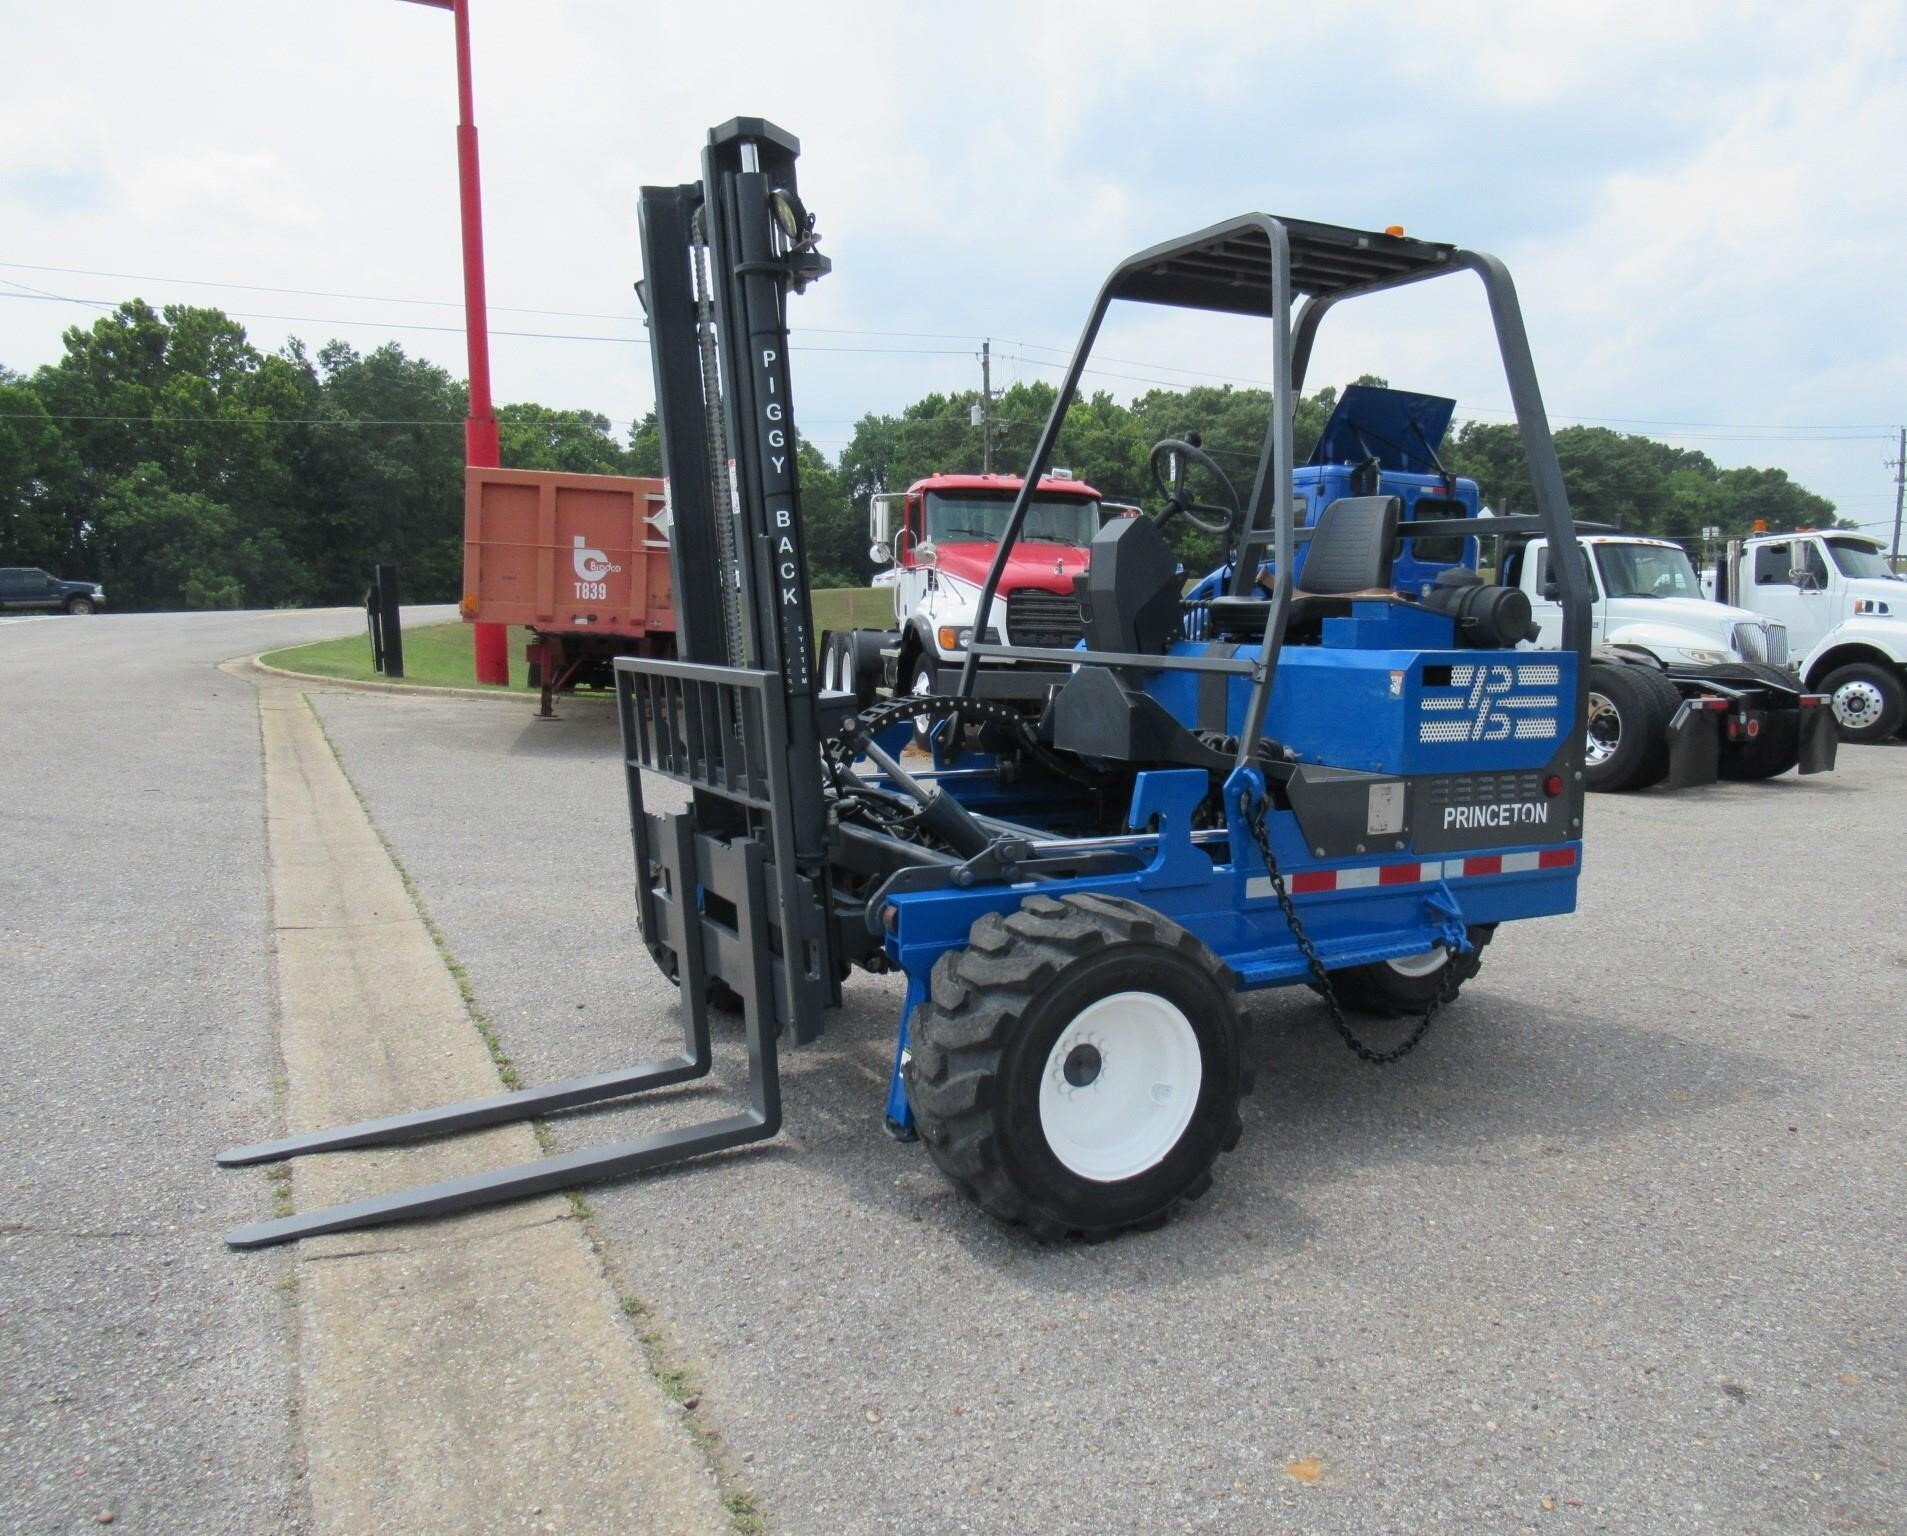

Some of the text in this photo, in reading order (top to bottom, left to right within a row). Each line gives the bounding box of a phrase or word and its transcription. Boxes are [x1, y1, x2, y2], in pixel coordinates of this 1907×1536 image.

[763, 350, 798, 605] PIGGY BACK
[574, 582, 607, 600] T839
[797, 625, 808, 685] SYSTEM
[1443, 802, 1549, 830] PRINCETON
